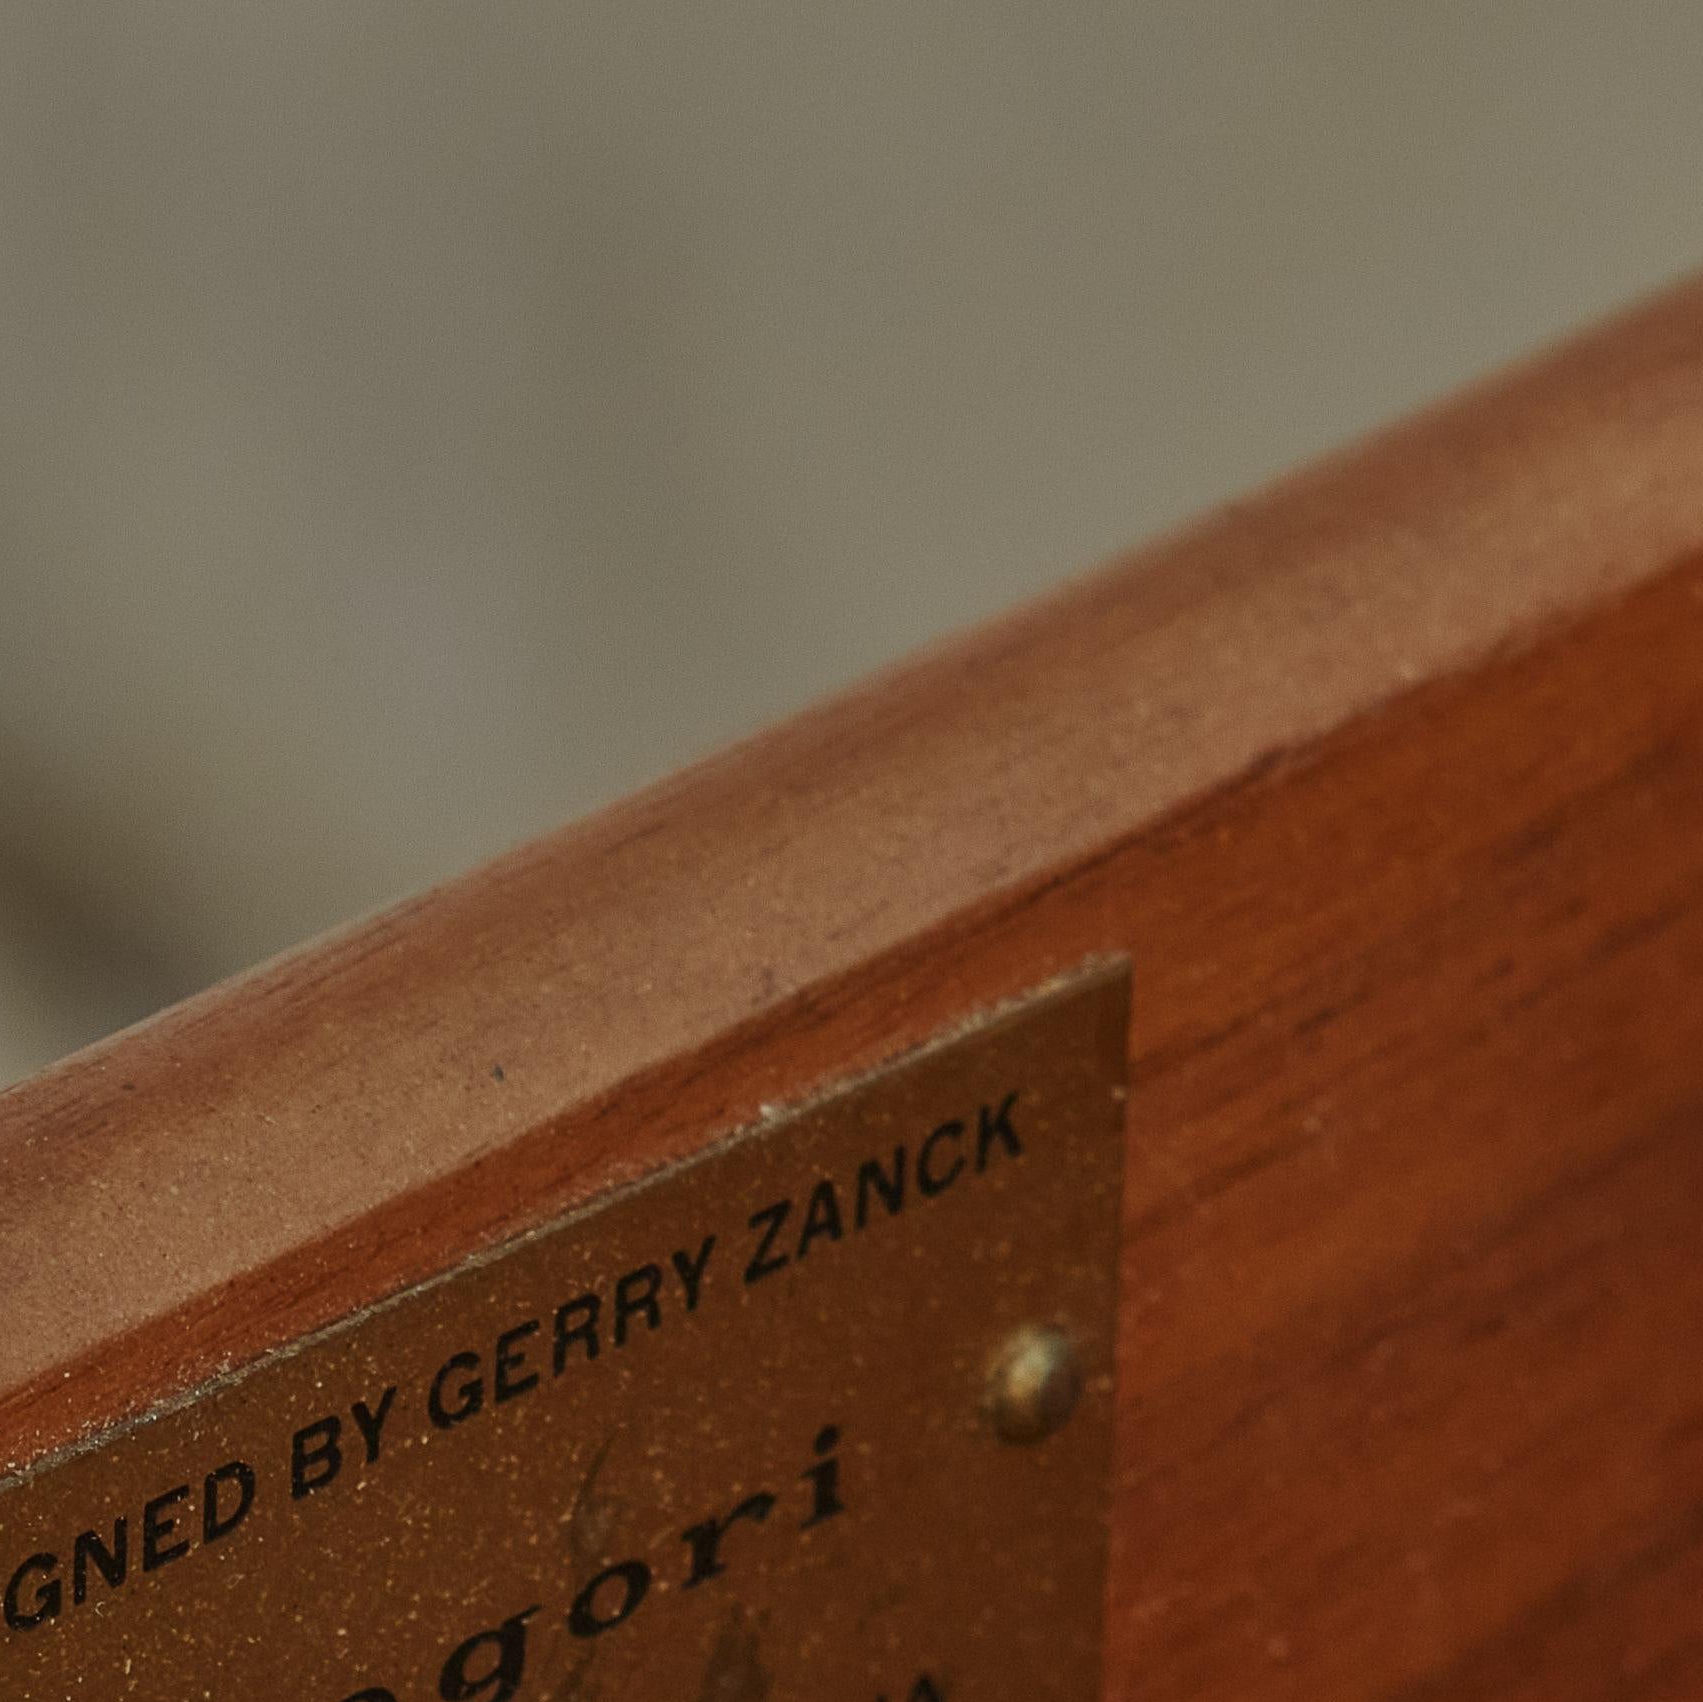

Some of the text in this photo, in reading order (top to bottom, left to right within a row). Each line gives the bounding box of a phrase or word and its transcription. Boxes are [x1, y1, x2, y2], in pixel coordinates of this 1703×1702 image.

[292, 1386, 401, 1501] BY
[430, 1235, 718, 1431] GERRY
[744, 1093, 1025, 1284] ZANCK
